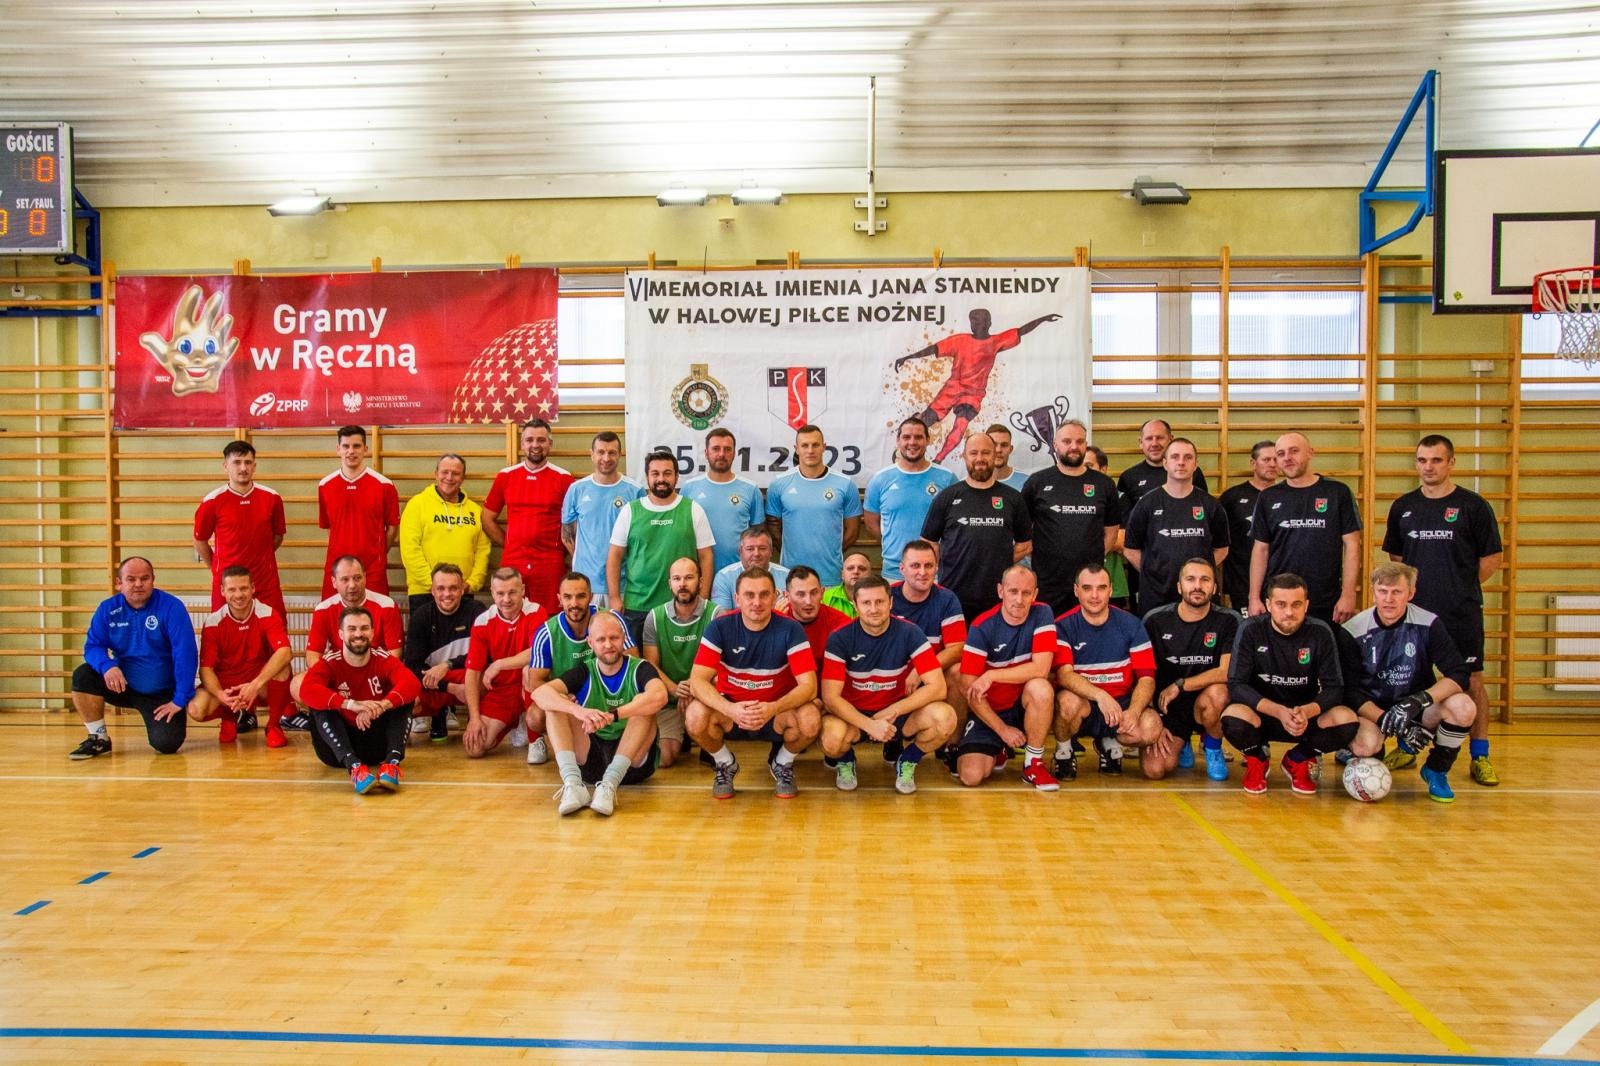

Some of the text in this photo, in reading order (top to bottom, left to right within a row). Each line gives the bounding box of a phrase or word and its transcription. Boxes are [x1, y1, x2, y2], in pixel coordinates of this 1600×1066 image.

[6, 131, 54, 152] GOŚCIE
[16, 198, 54, 209] SET/FAUL
[629, 277, 1060, 301] VI MEMORIAŁ IMIENIA JANA STANIENDY
[273, 303, 387, 338] Gramy
[648, 301, 945, 327] W HALOWEJ PIŁCE NOŻNEJ
[250, 339, 418, 376] w Ręczną
[276, 399, 309, 412] ZPRP
[1062, 505, 1096, 513] SOLIDUM
[970, 517, 1004, 525] SOLIDUM
[1290, 519, 1326, 527] SOLIDUM
[1171, 528, 1204, 536] SOLIDUM
[1420, 530, 1453, 538] SOLIDUM
[1180, 655, 1213, 663] SOLIDUM
[1371, 646, 1376, 664] 1
[367, 676, 383, 696] 18
[1272, 675, 1308, 684] SOLIDUM
[964, 720, 975, 737] 9
